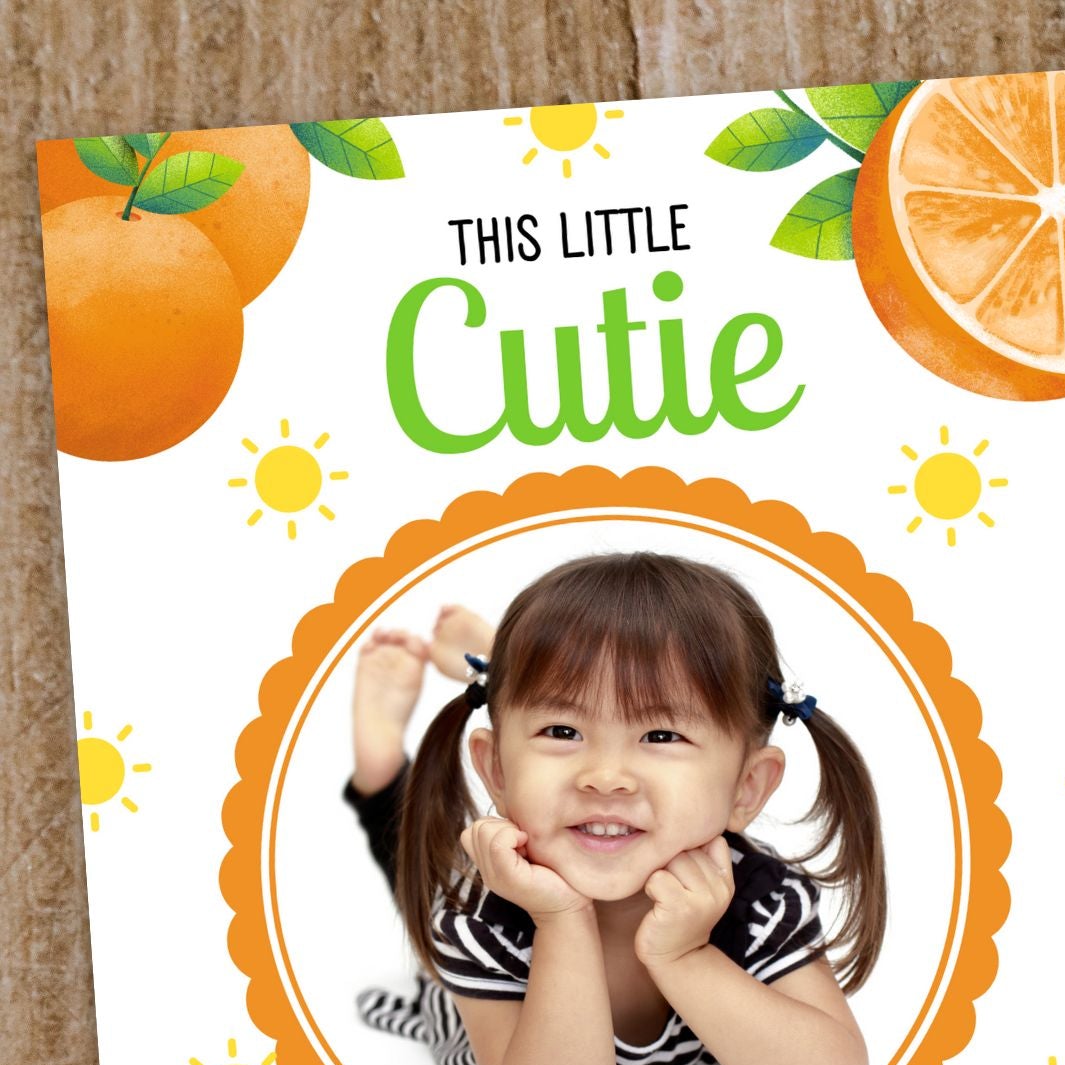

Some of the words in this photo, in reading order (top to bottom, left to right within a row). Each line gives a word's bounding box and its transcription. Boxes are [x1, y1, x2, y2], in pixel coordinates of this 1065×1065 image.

[447, 213, 542, 266] THIS
[559, 203, 691, 259] LITTLE
[386, 271, 805, 455] Cutie
